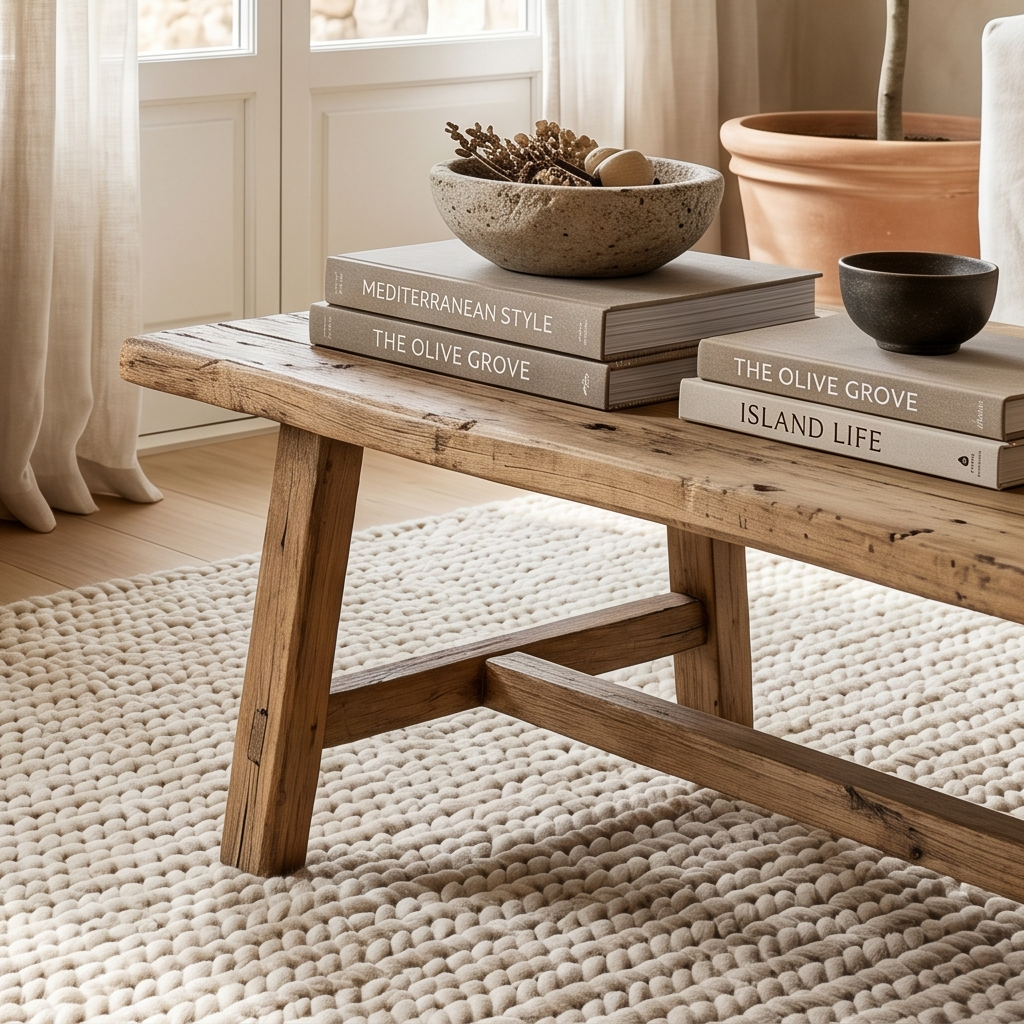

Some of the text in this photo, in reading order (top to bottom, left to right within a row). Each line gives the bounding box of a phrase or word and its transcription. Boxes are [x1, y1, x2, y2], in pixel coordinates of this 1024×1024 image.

[362, 279, 496, 322] MEDITERRANEAN
[501, 307, 553, 334] STYLE
[372, 329, 530, 381] THE OLIVE GROVE
[734, 357, 918, 412] THE OLIVE GROVE
[740, 402, 882, 453] ISLAND LIFE
